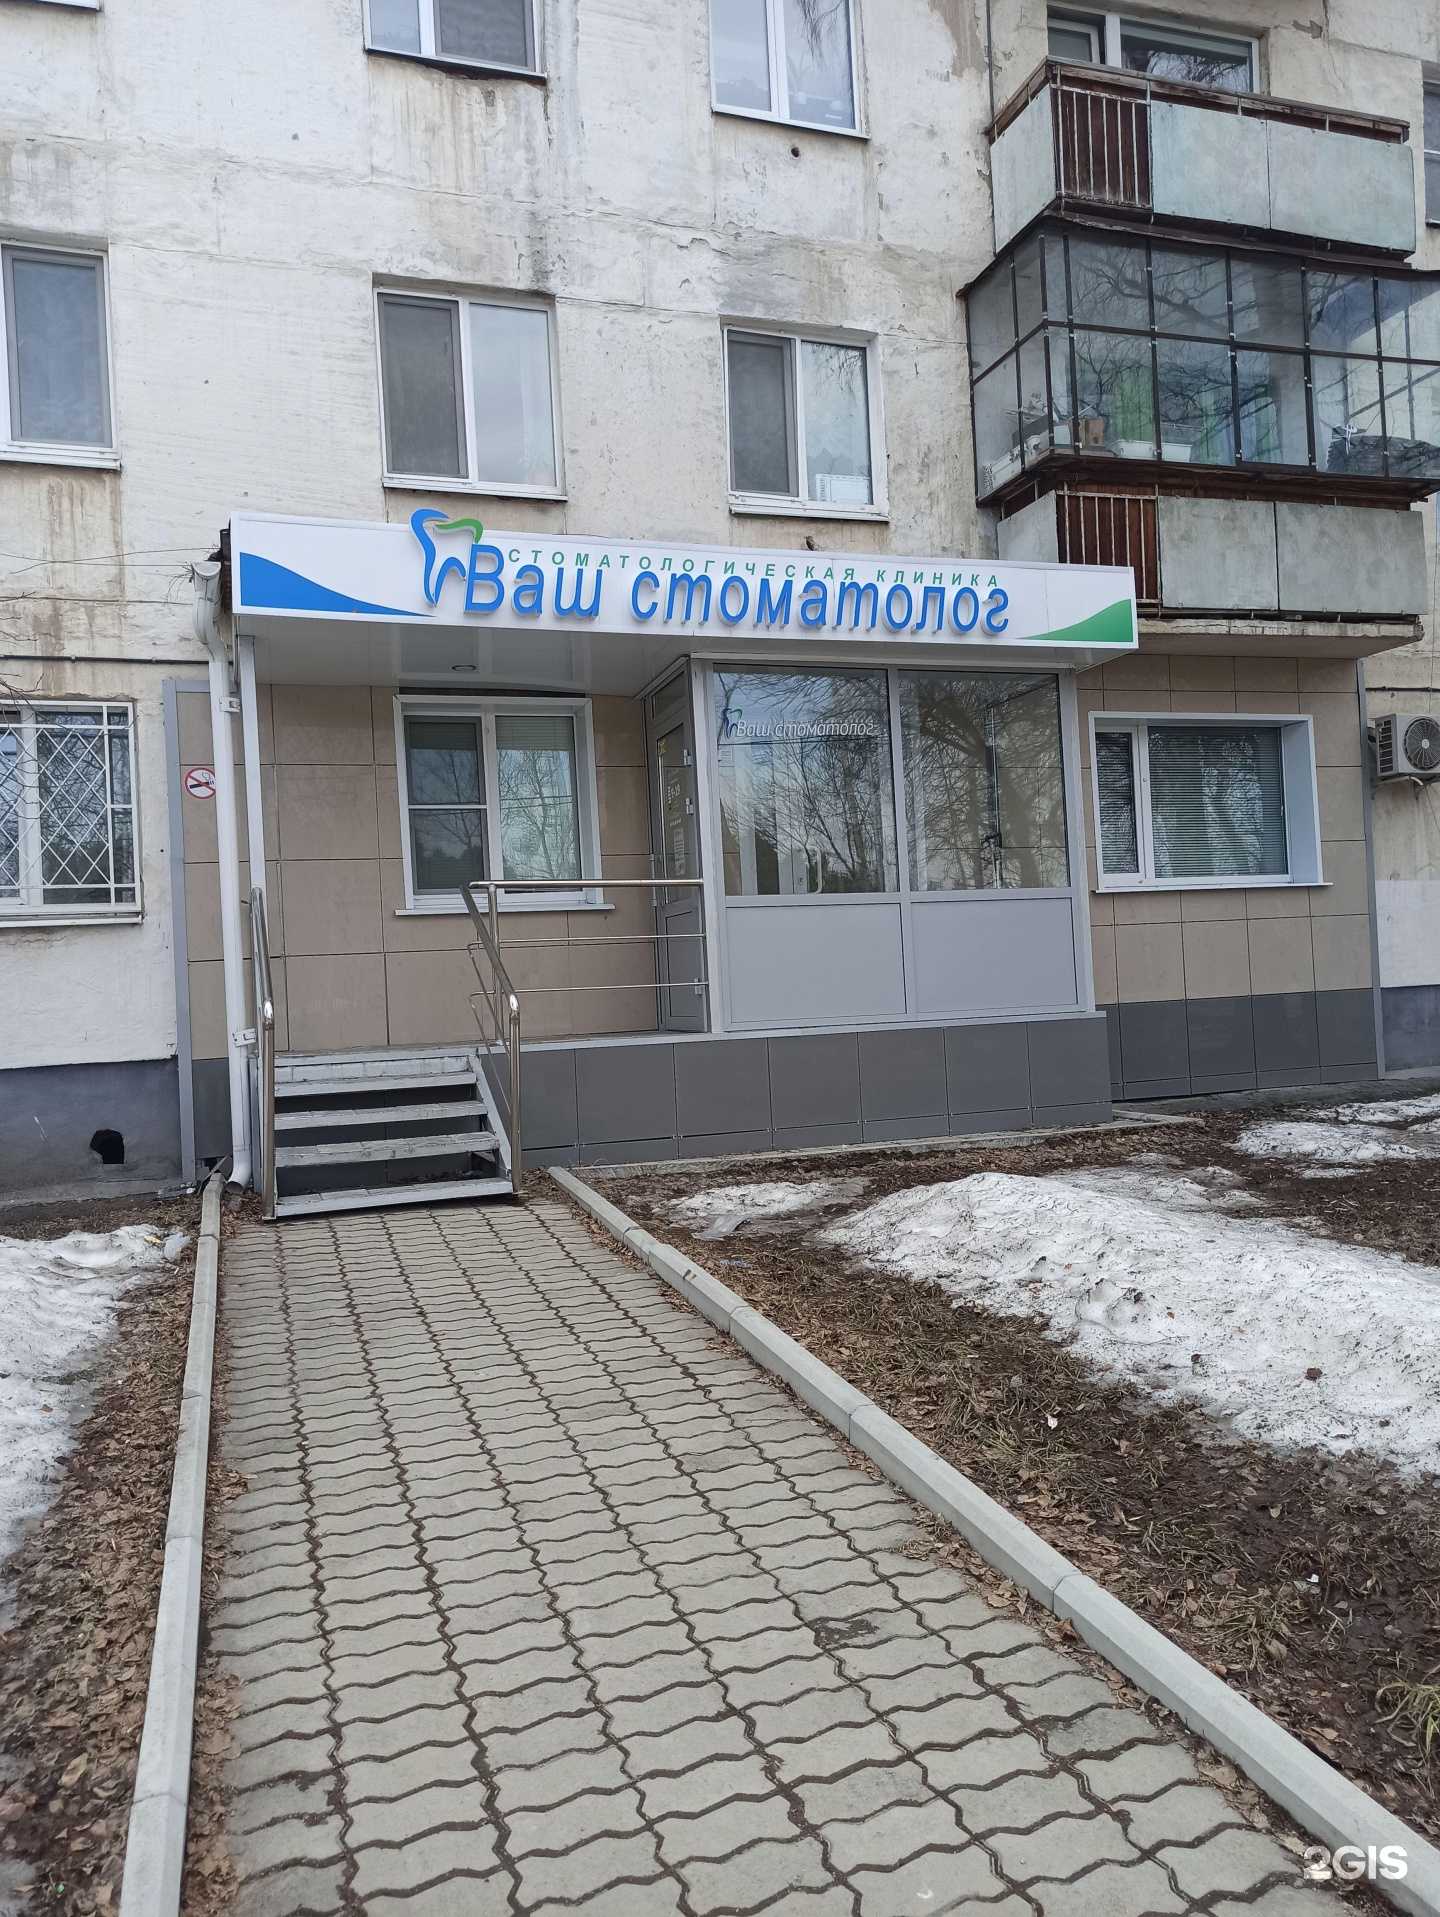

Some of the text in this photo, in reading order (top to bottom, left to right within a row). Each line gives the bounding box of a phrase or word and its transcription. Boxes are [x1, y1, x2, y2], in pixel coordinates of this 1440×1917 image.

[509, 549, 998, 588] СТОМАТОЛОГИЧЕСКАЯ КЛИНИКА
[465, 544, 1010, 635] Ваш стоматолог
[736, 720, 874, 738] Ваш стоматолог
